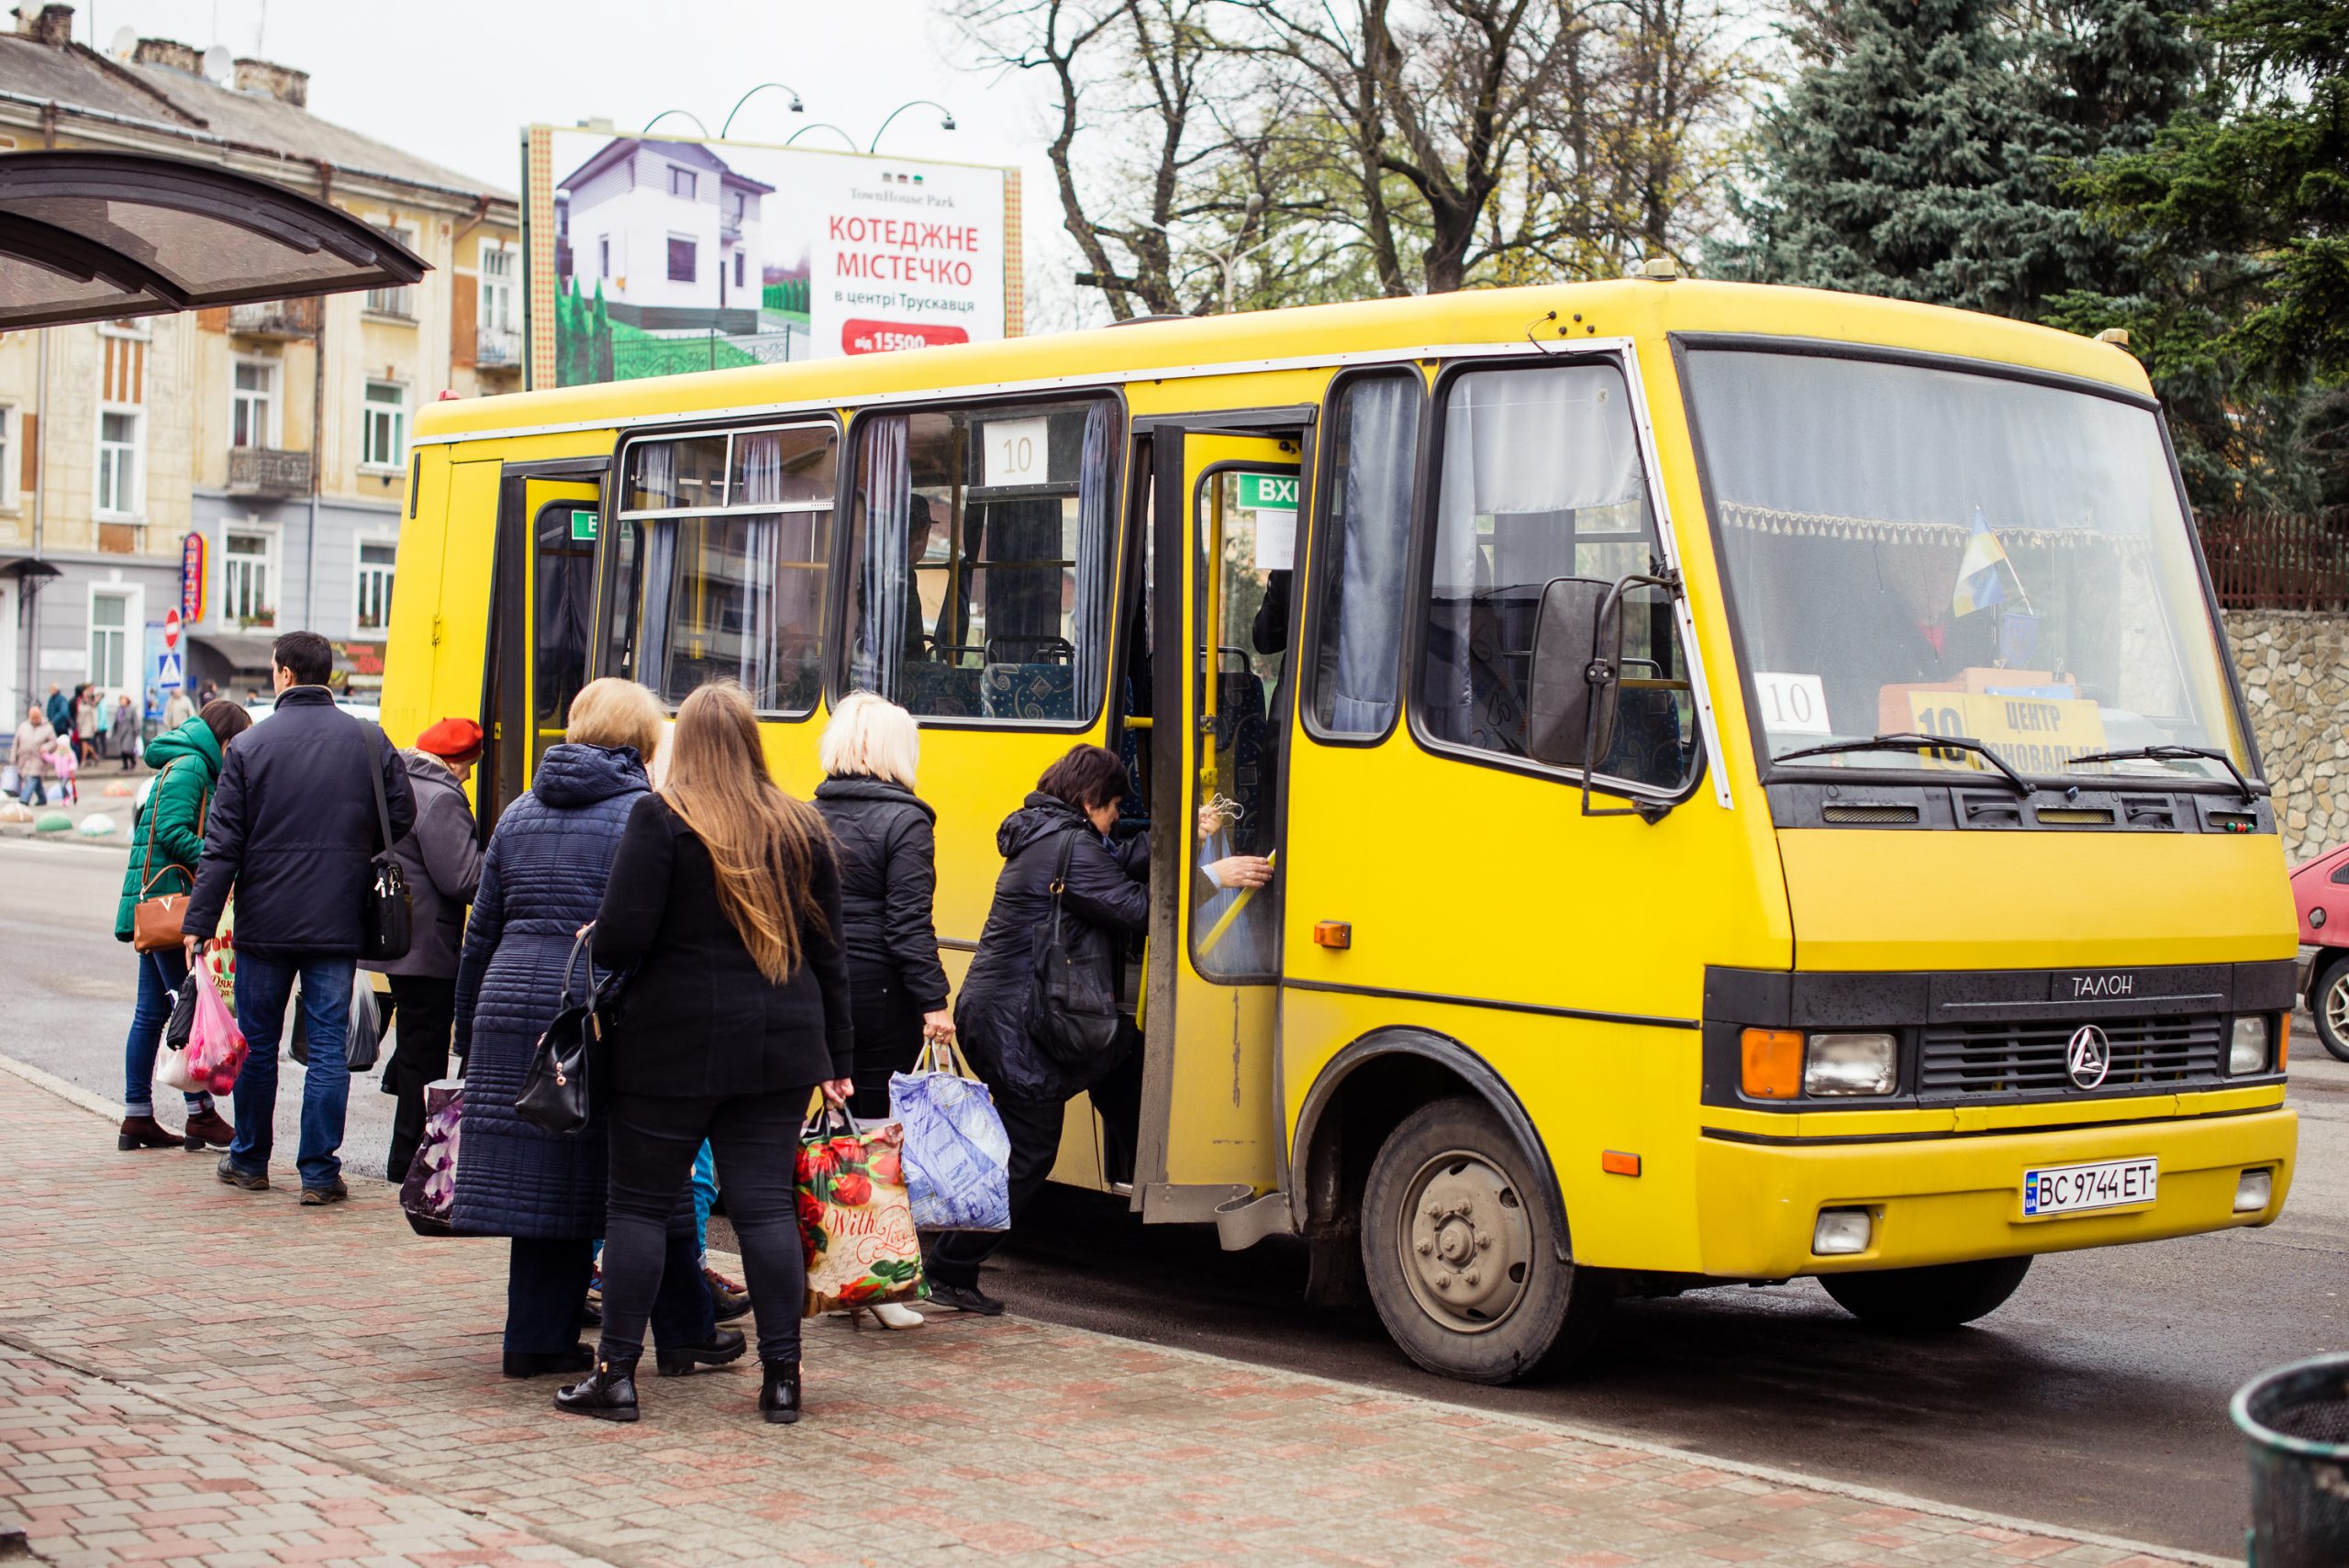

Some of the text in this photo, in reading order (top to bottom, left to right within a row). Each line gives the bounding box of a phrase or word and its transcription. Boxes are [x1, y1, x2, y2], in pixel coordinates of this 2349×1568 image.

[850, 188, 955, 208] TownHouse Park
[829, 216, 979, 252] КОТЕДЖНЕ
[837, 252, 973, 286] МІСТЕЧКО
[834, 291, 975, 313] в центрі Трускавця
[1003, 437, 1033, 474] 10
[1258, 478, 1299, 503] ВХІ
[1767, 683, 1812, 723] 10
[2005, 701, 2062, 733] ЦЕНТР
[1919, 706, 1967, 763] 10
[2071, 975, 2133, 997] ТАЛОН
[2039, 1165, 2152, 1207] BC 9744 ET
[2025, 1198, 2036, 1208] UA
[825, 1208, 875, 1240] With
